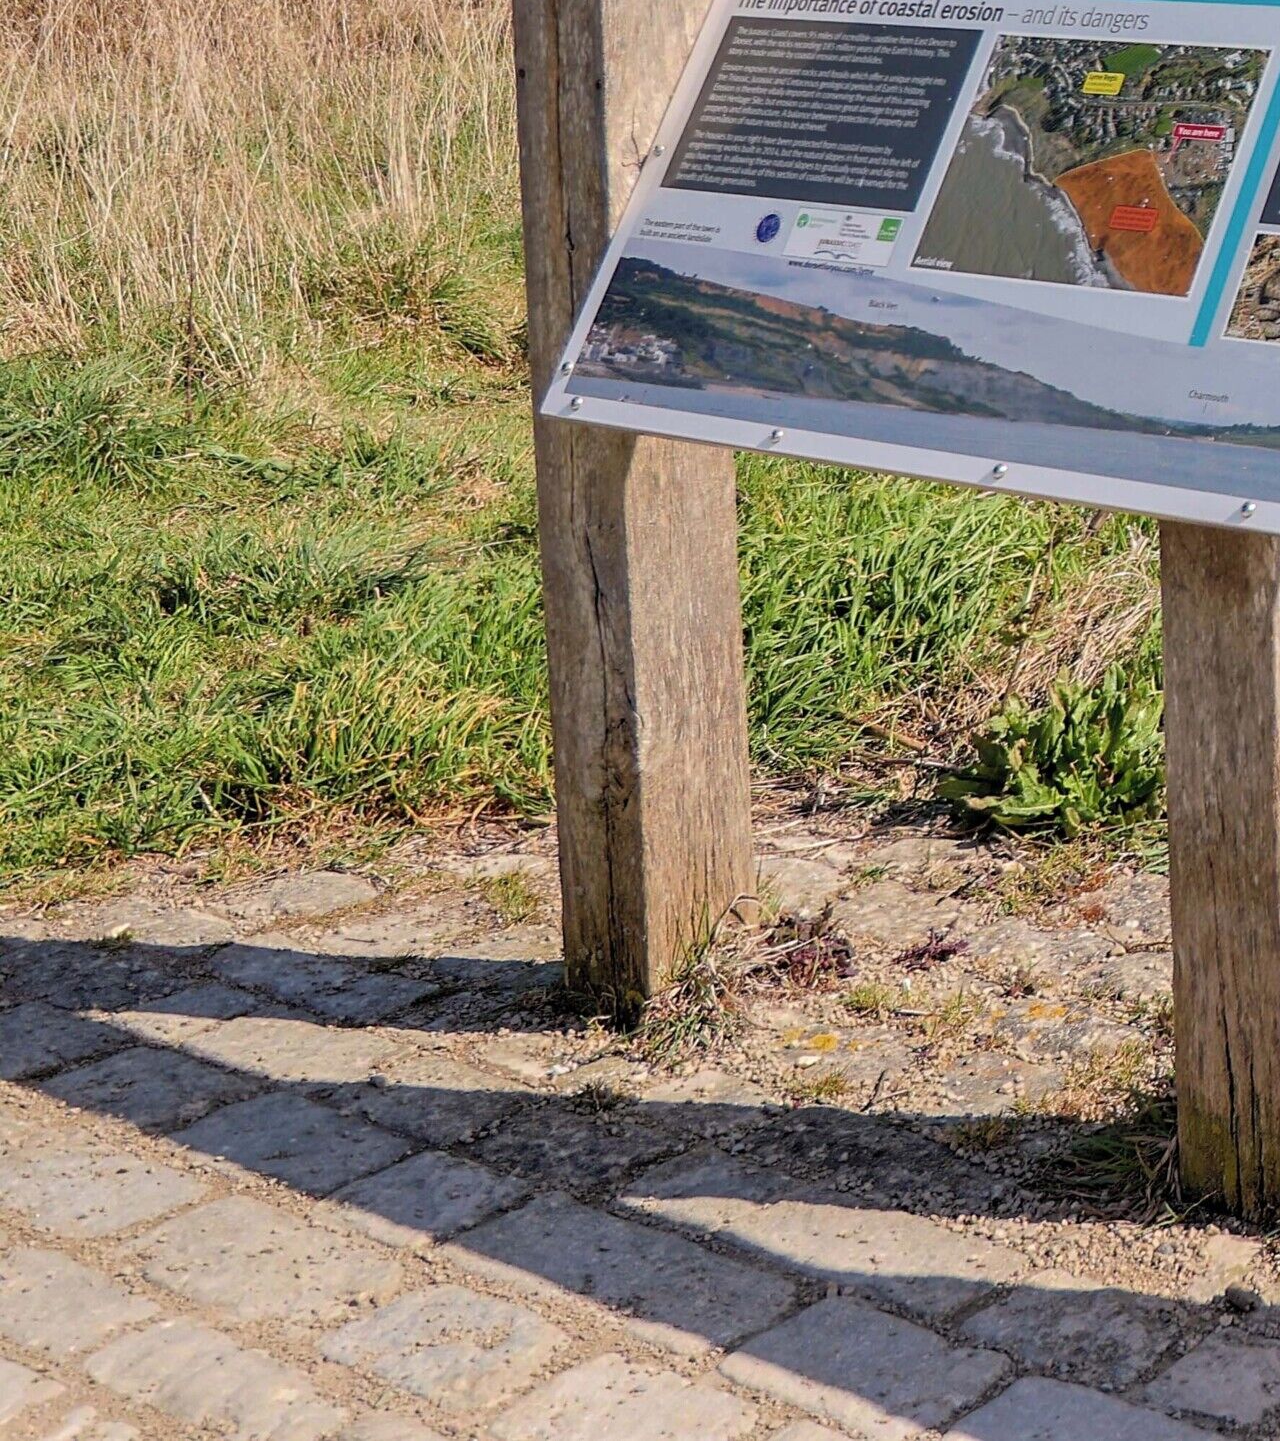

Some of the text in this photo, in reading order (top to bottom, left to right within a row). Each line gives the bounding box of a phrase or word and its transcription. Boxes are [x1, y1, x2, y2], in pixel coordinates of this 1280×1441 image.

[879, 0, 939, 19] coastal
[941, 4, 1003, 23] erosion
[1021, 5, 1054, 26] and
[1058, 9, 1077, 27] its
[1081, 10, 1150, 33] dangers
[1178, 128, 1219, 138] You are here
[1188, 388, 1229, 405] Charmouth
